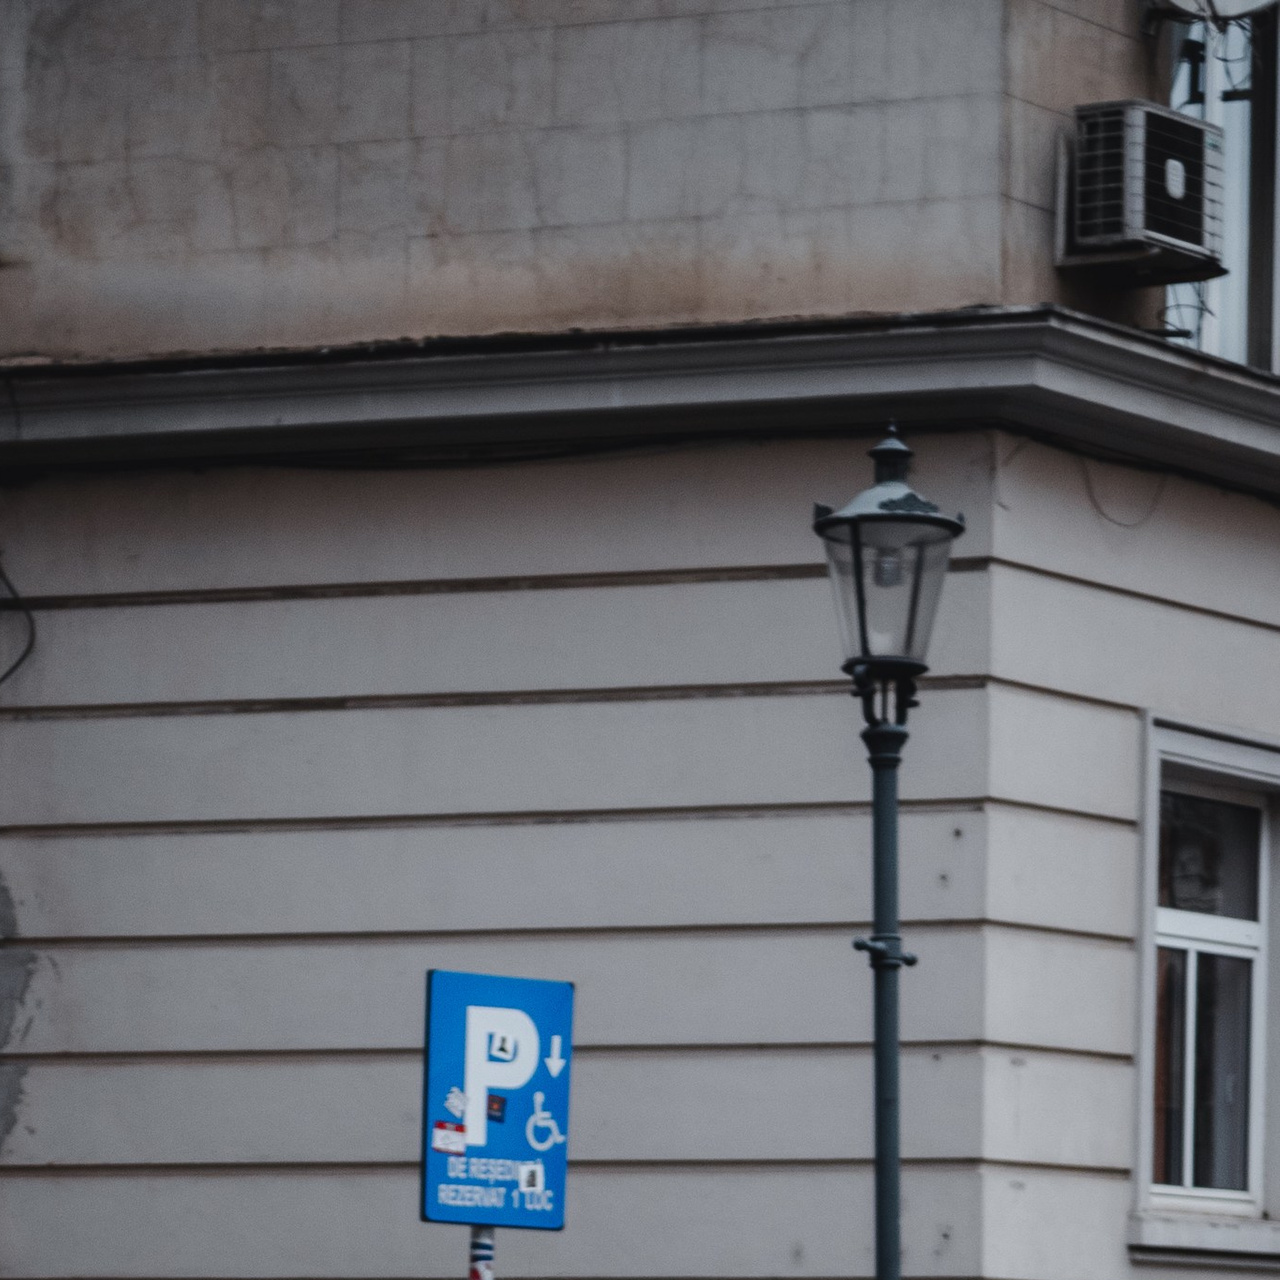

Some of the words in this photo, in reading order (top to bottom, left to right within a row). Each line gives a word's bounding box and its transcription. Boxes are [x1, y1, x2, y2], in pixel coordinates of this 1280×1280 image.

[465, 1005, 540, 1146] P
[447, 1156, 467, 1179] DE
[438, 1184, 506, 1208] REZERVAT
[511, 1189, 519, 1208] 1
